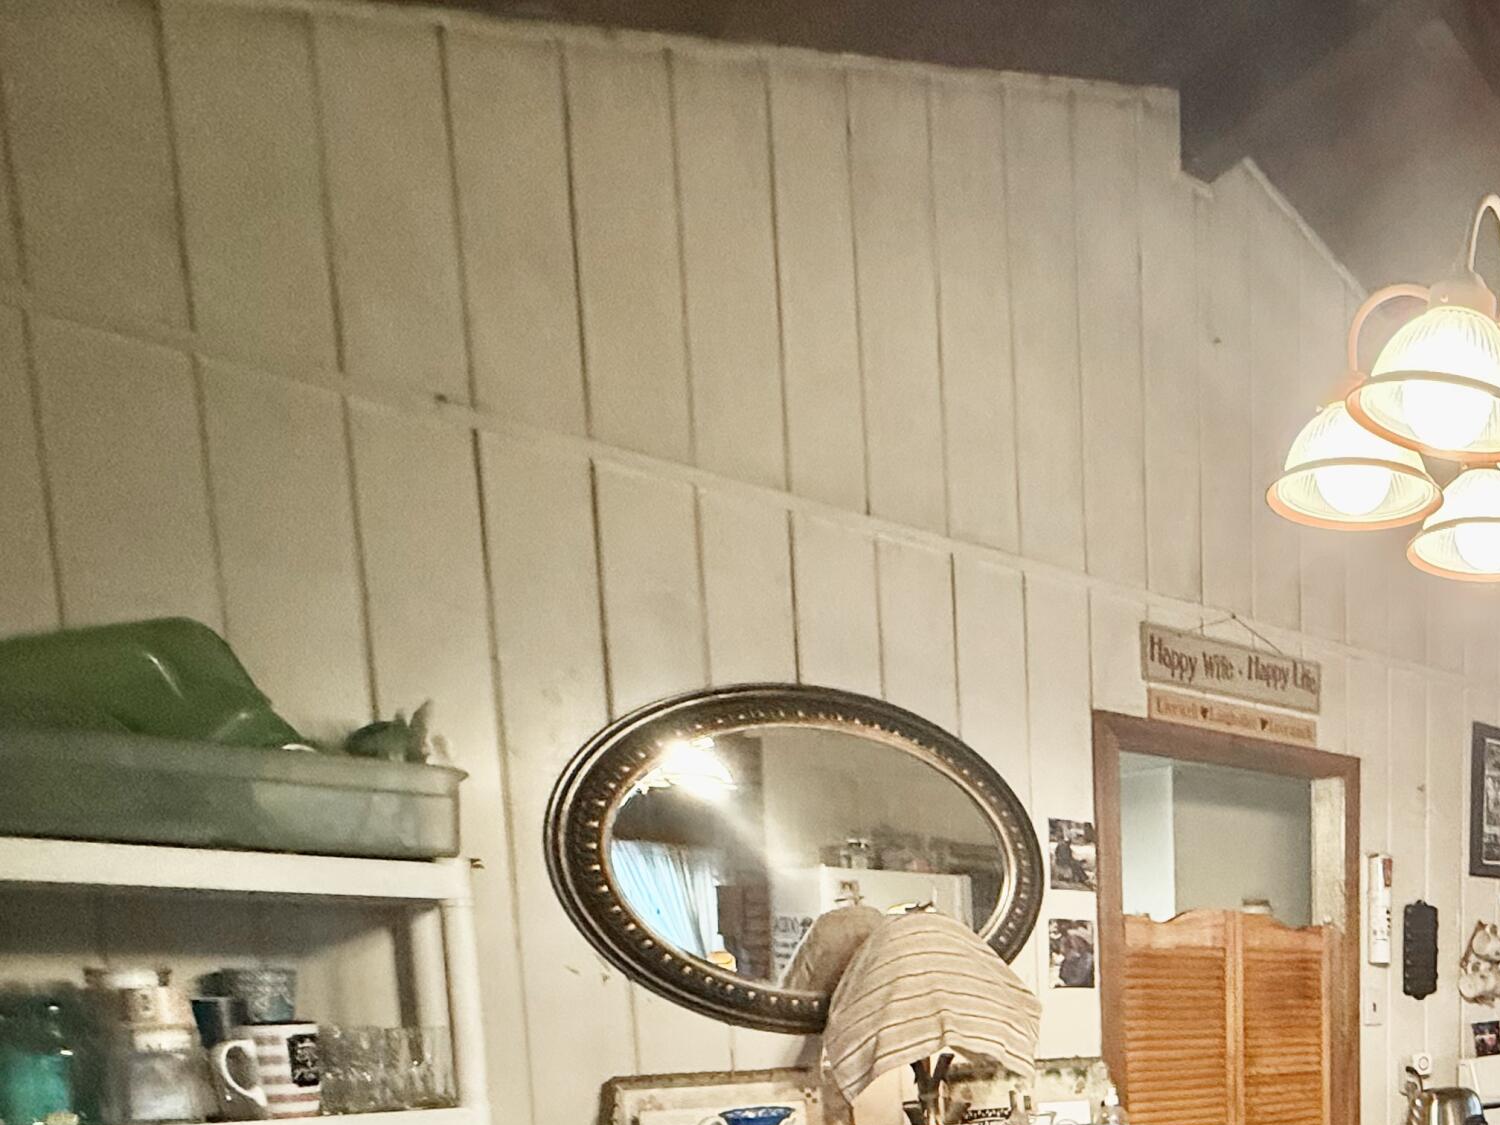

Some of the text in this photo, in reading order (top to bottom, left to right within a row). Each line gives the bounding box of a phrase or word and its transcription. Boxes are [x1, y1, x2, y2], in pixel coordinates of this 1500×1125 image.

[1150, 632, 1317, 696] Happy Wife Happy Life
